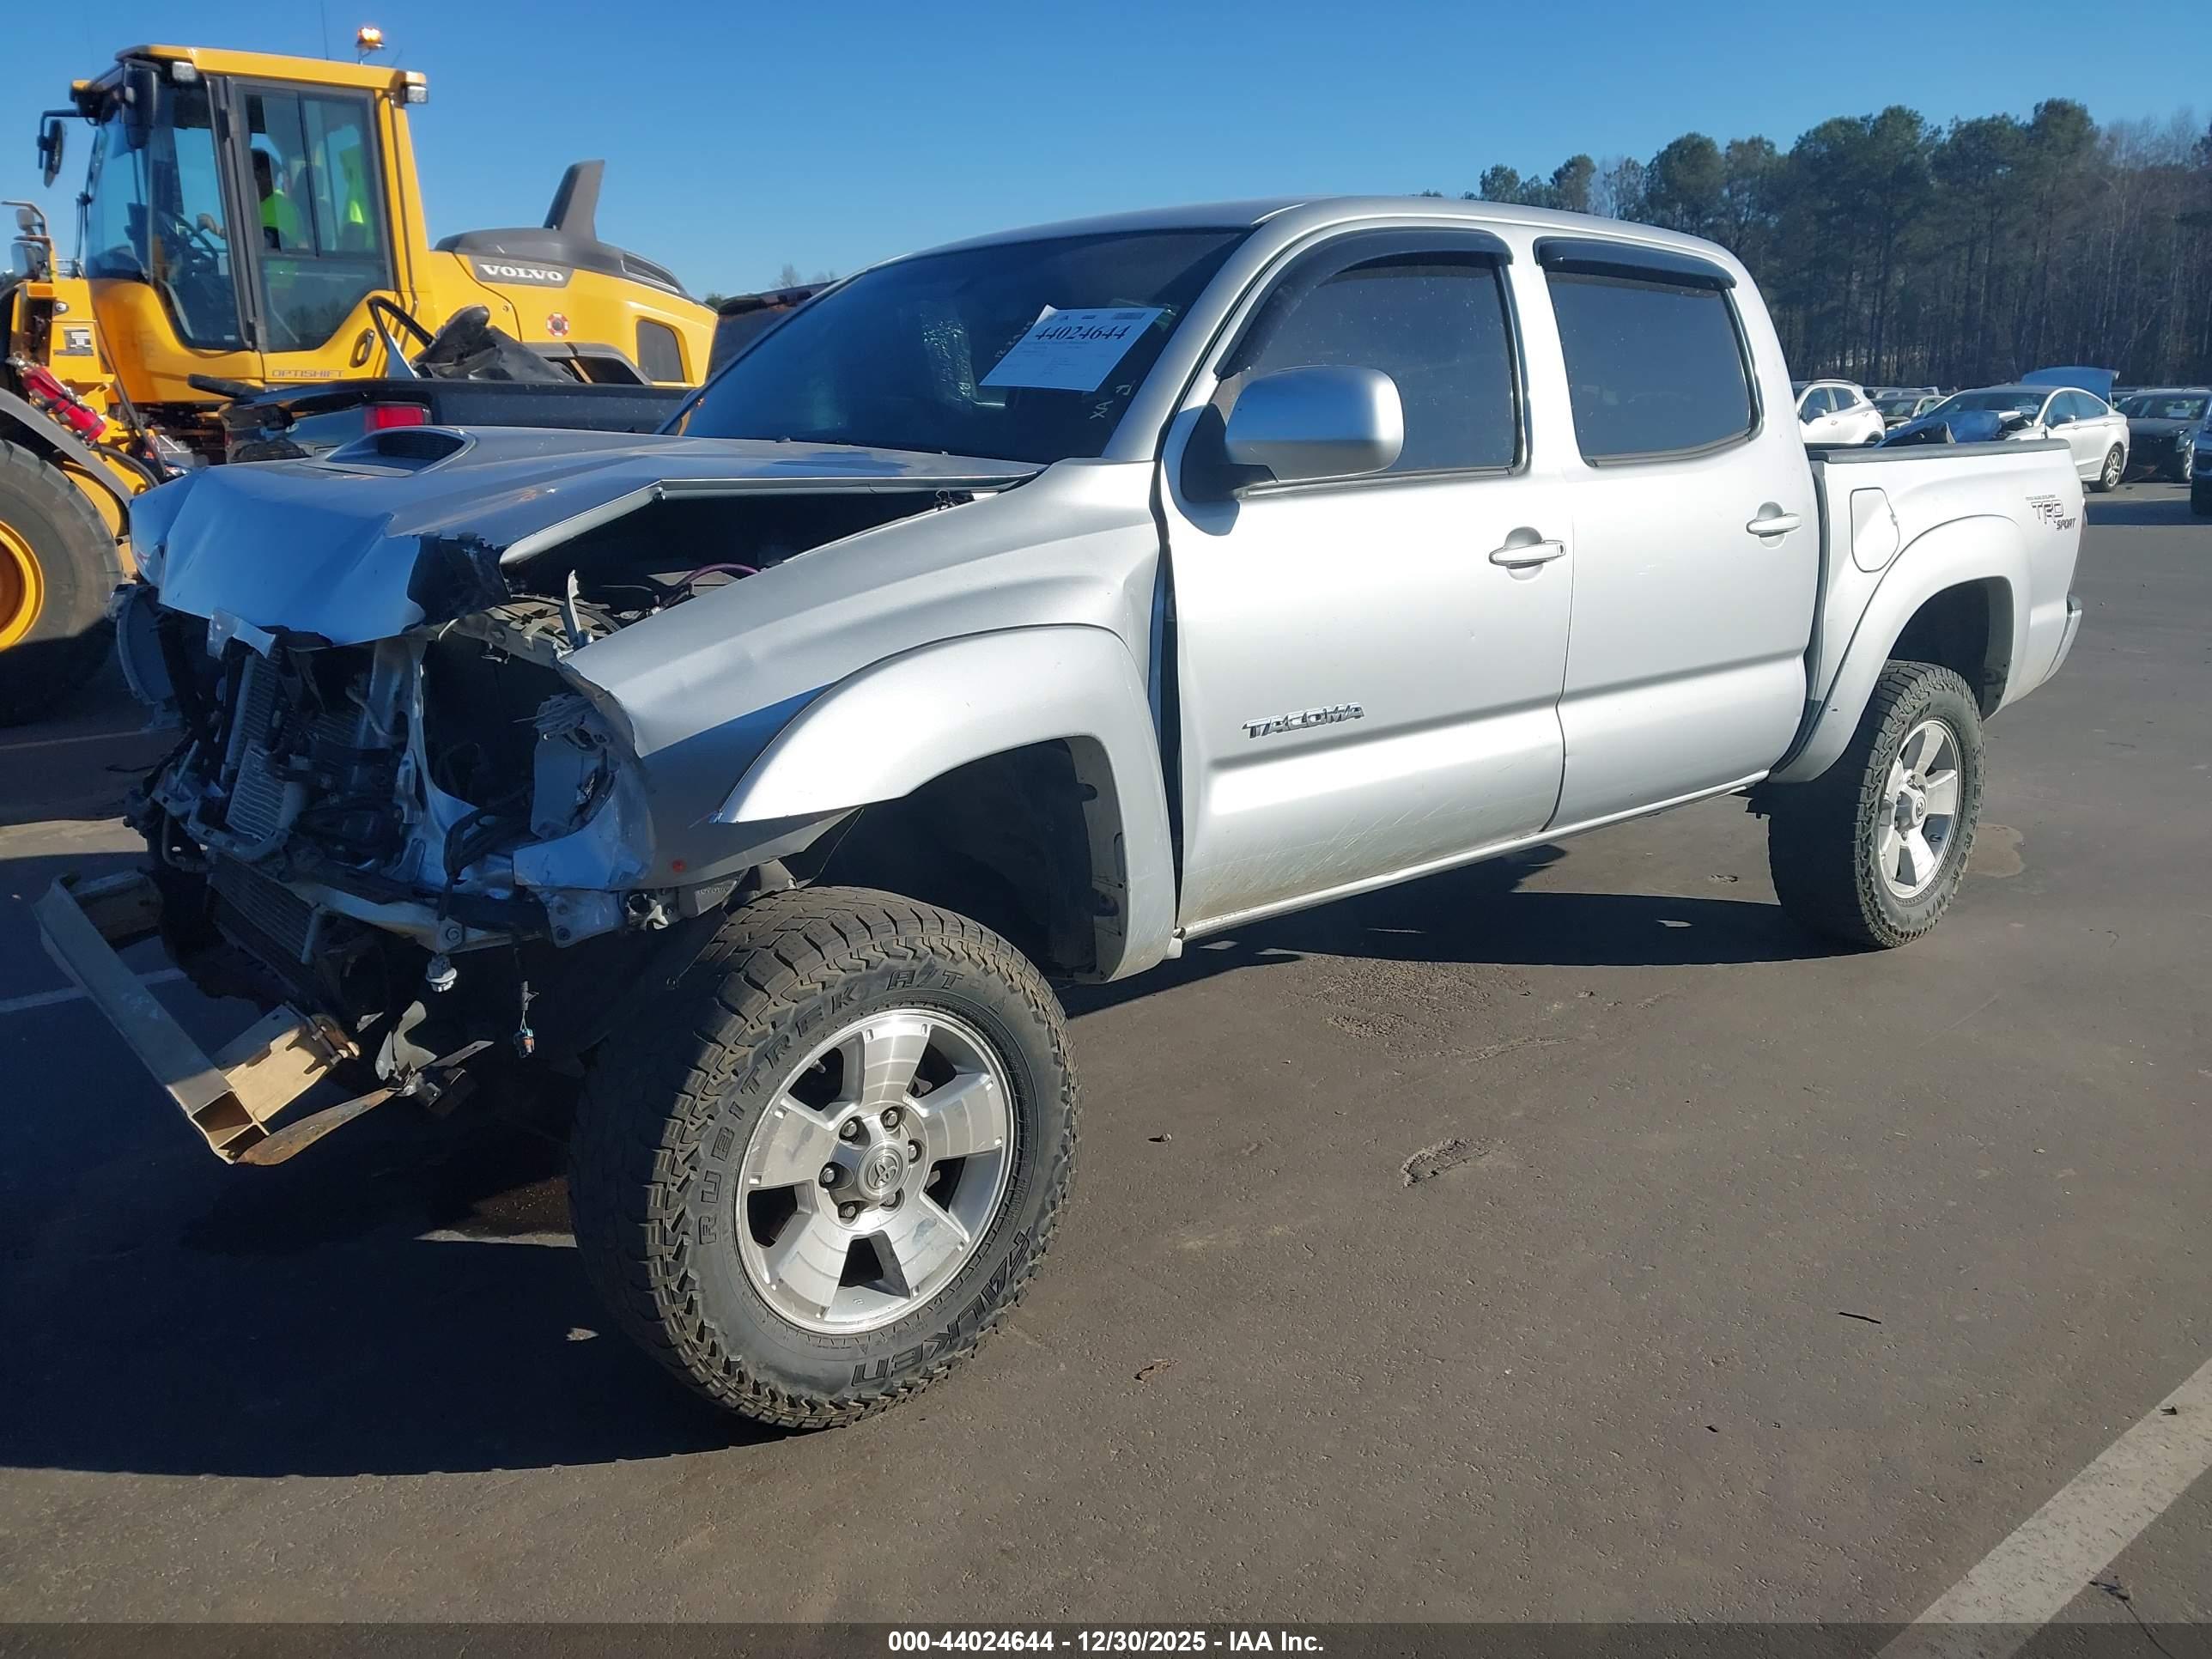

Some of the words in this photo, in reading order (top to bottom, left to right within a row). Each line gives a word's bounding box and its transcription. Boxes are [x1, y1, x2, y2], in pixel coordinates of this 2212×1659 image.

[478, 263, 564, 282] VOLVO
[1036, 325, 1132, 341] 44024644
[2031, 499, 2064, 526] TRD
[2056, 517, 2076, 531] SPORT
[1242, 702, 1364, 739] TACOMA
[886, 968, 964, 992] A/T
[850, 1225, 1032, 1387] FALKEN
